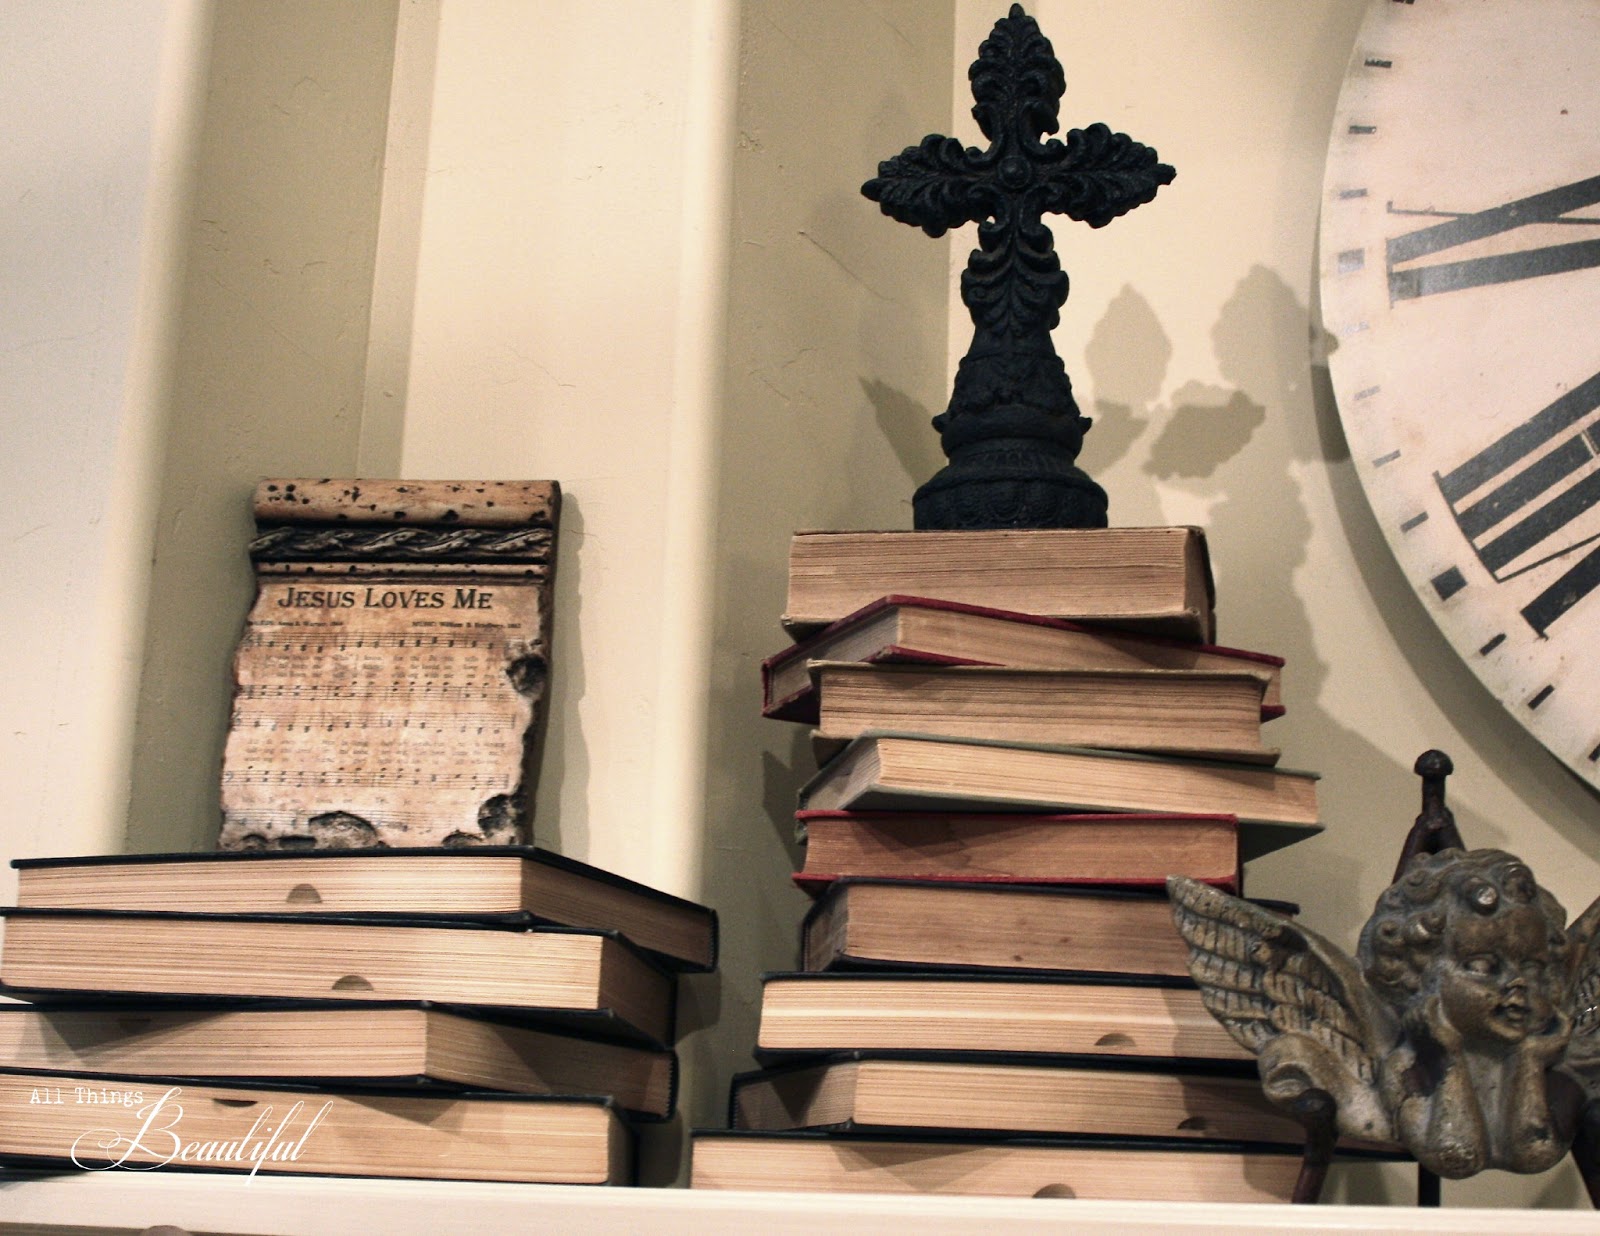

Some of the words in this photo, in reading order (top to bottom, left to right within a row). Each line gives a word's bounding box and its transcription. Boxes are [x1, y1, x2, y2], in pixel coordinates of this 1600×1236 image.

[277, 587, 356, 609] JESUS
[363, 587, 445, 609] LOVES
[452, 588, 493, 609] ME
